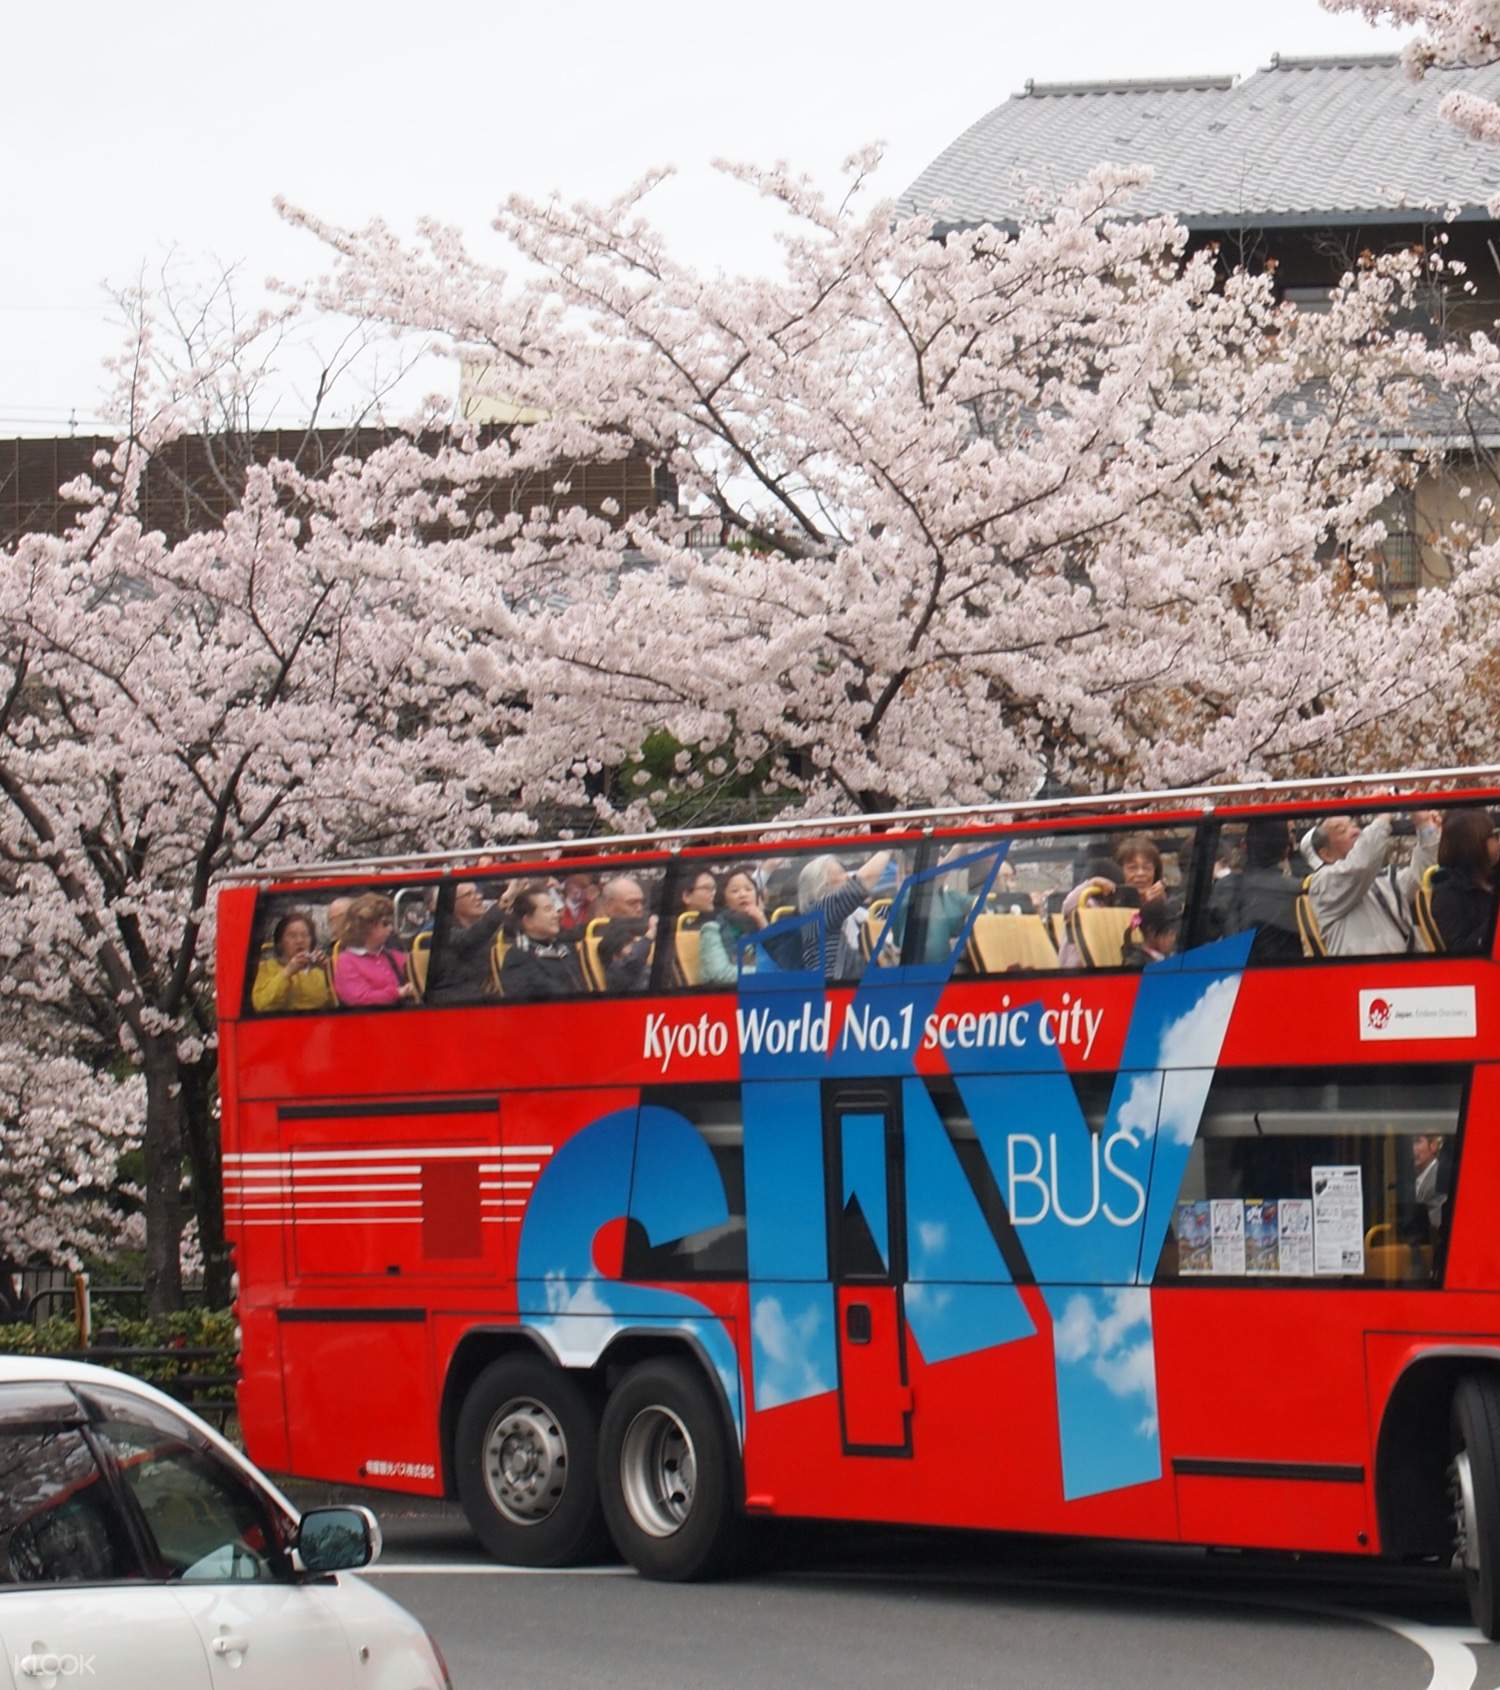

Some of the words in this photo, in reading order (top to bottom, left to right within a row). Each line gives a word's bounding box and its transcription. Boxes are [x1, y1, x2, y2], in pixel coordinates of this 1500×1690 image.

[643, 1013, 728, 1073] Kyoto
[735, 1002, 832, 1055] World
[843, 1001, 913, 1050] No.1
[924, 995, 1028, 1047] scenic
[1039, 992, 1104, 1061] city
[1008, 1131, 1146, 1226] BUS
